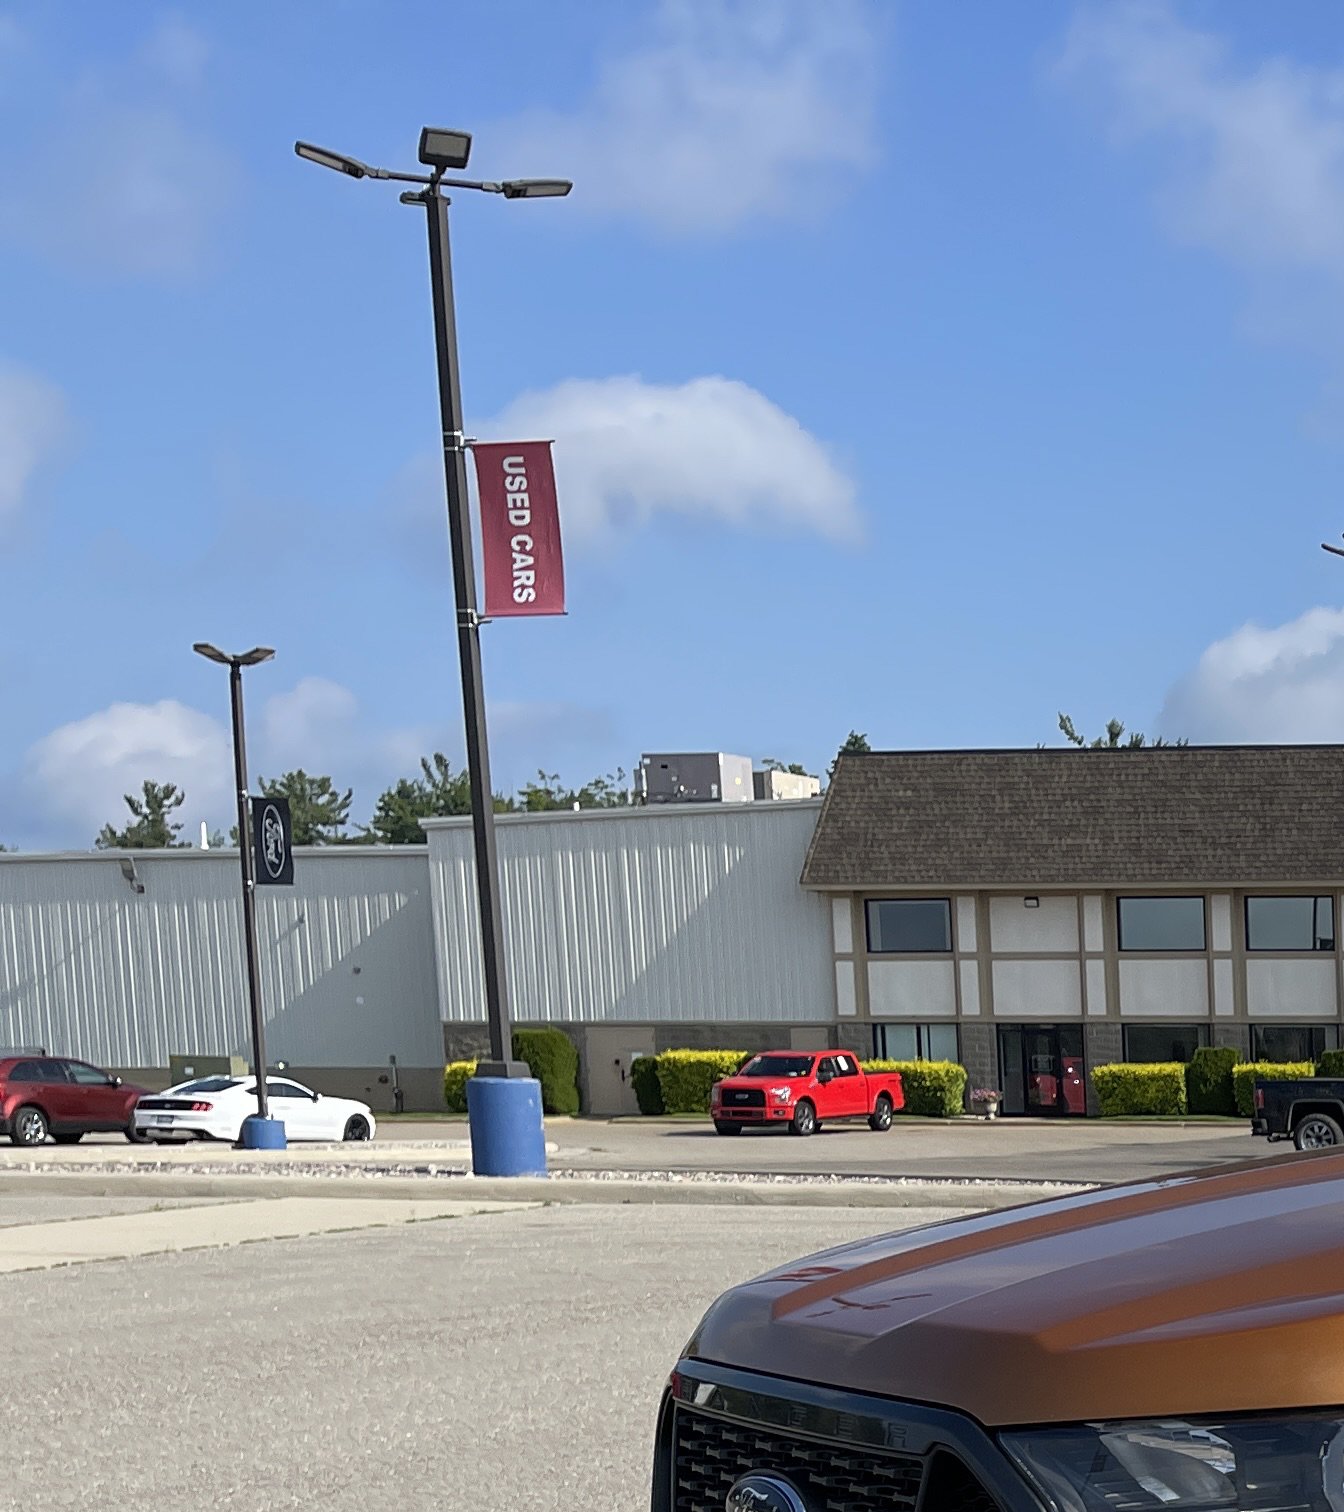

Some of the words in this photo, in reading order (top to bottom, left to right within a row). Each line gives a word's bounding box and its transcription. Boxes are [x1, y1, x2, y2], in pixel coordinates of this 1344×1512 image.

[502, 455, 531, 527] USED
[510, 533, 536, 604] CARS
[265, 817, 281, 864] Ford
